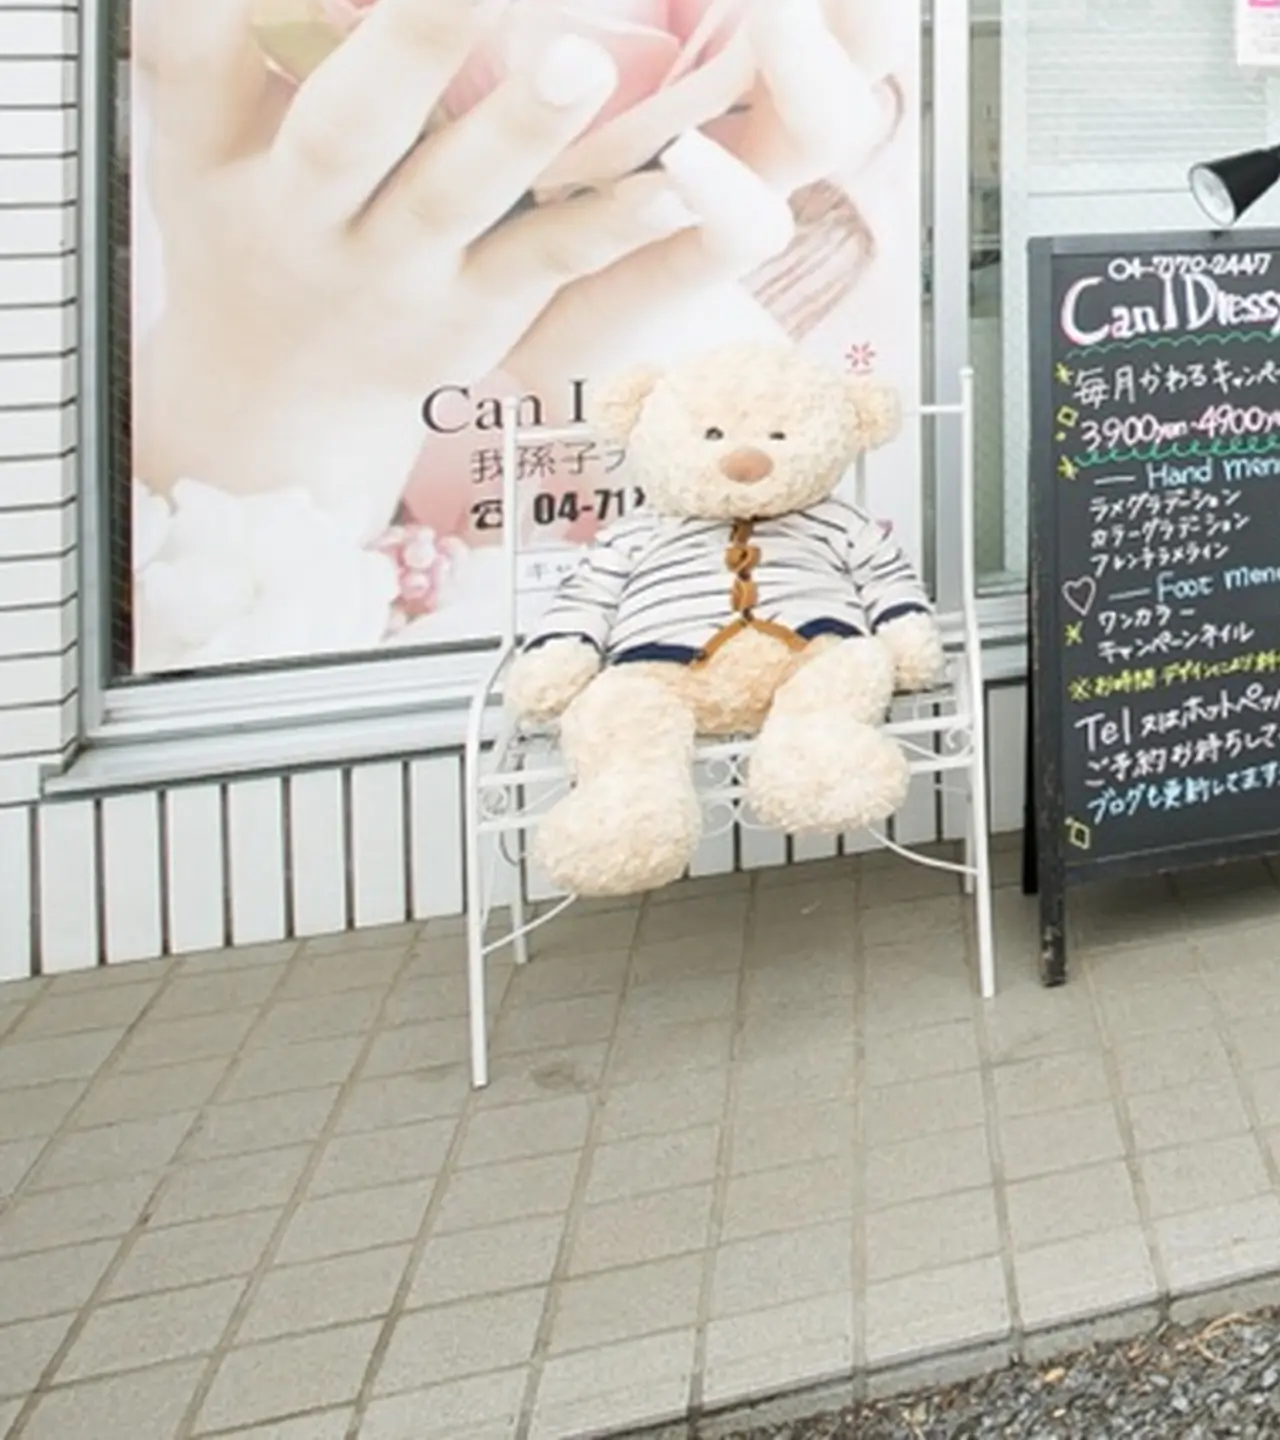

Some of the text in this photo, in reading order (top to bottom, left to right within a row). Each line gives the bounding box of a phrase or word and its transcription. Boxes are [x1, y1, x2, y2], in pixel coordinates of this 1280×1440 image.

[1108, 252, 1272, 282] 04-7170-2447
[1061, 275, 1161, 346] Can
[421, 378, 589, 435] Can I
[1146, 457, 1213, 490] Hand
[1155, 570, 1214, 604] Foot
